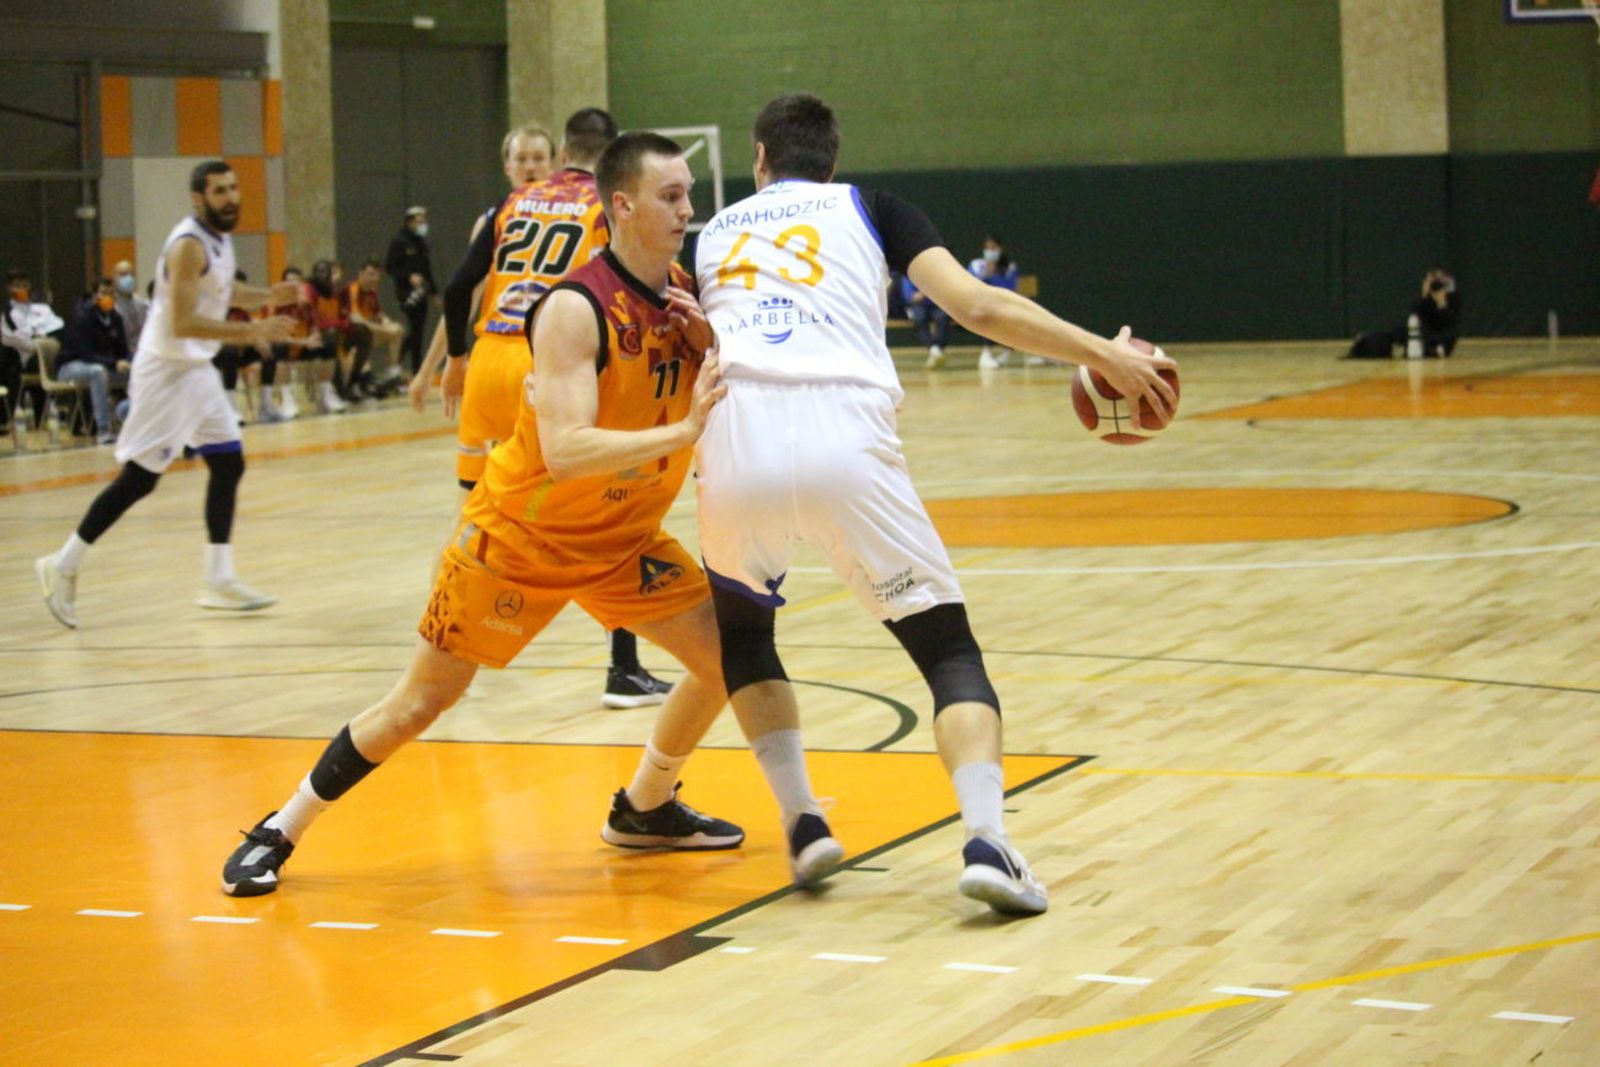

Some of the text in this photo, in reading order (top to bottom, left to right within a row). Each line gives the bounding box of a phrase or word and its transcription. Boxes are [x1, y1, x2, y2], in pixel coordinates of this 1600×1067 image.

[514, 199, 589, 217] MULERO
[496, 219, 586, 277] 20
[716, 224, 824, 290] 43
[655, 359, 681, 399] 11
